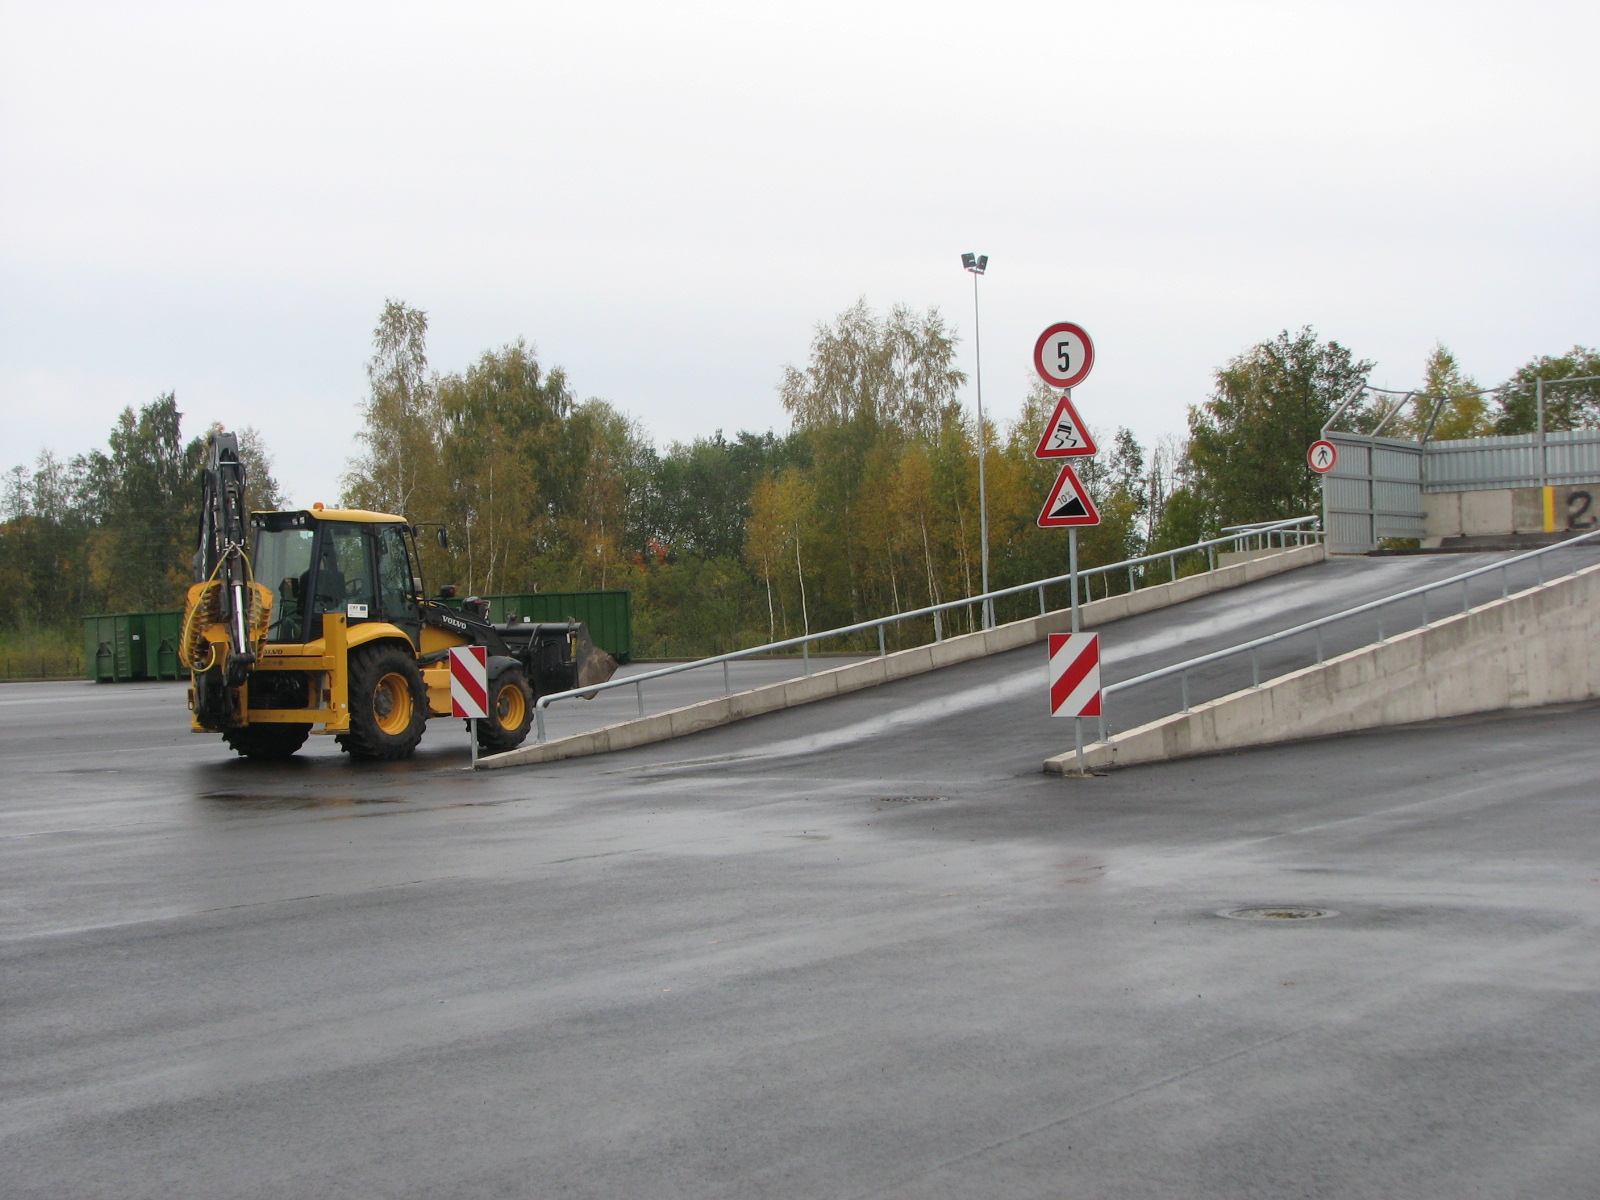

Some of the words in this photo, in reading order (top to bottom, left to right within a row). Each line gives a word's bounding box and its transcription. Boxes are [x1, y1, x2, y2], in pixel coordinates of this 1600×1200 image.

[1058, 342, 1070, 372] 5
[1058, 491, 1073, 505] 10%
[441, 615, 467, 629] VOLVO
